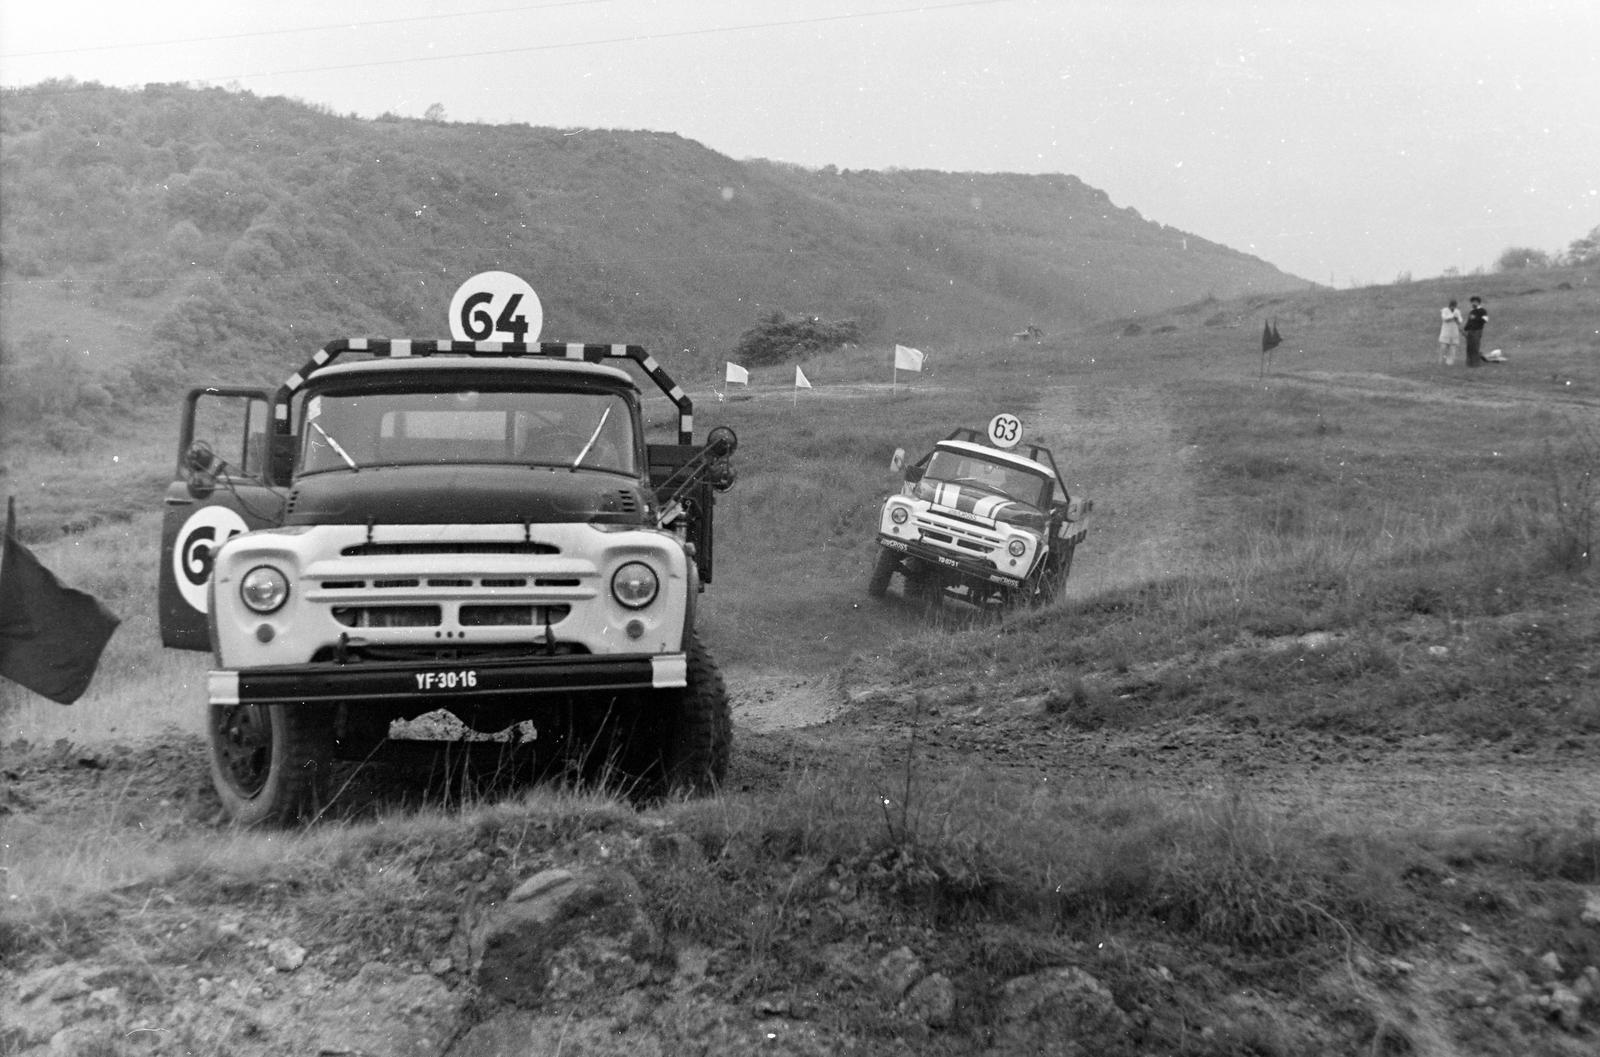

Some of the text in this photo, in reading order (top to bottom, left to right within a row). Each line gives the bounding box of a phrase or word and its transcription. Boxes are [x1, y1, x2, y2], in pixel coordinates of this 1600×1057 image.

[461, 291, 529, 343] 64
[994, 417, 1018, 441] 63
[182, 525, 241, 586] 6
